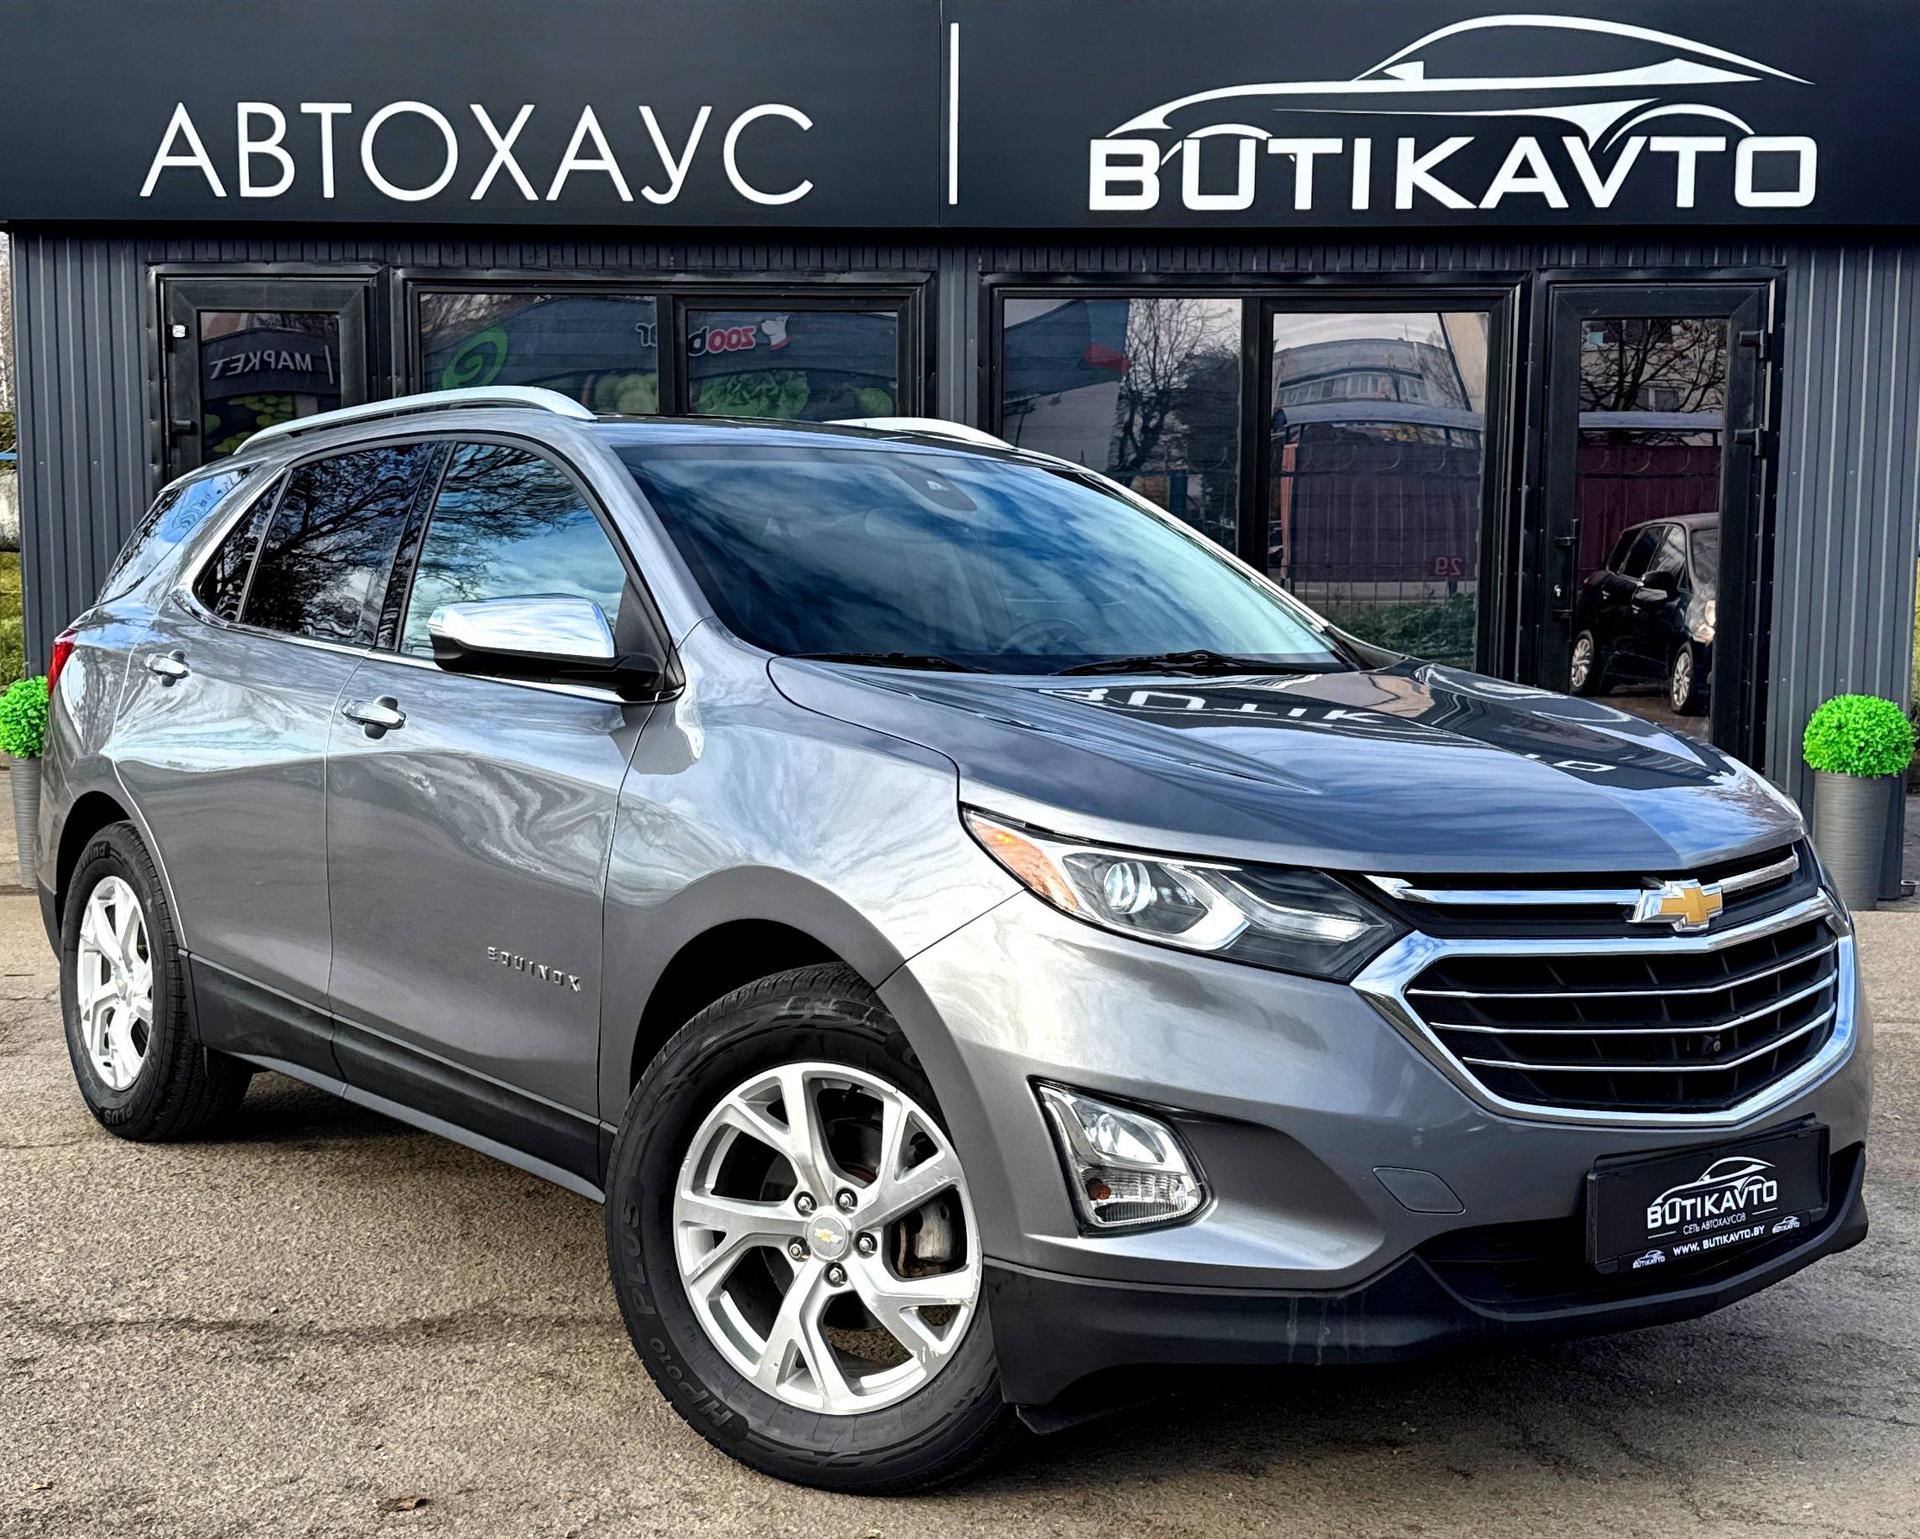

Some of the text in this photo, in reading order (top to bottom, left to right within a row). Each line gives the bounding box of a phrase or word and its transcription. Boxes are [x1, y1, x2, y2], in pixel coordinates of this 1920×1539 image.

[140, 100, 815, 205] АВТОХАУС
[1088, 135, 1818, 211] BUTIKAVTO
[487, 946, 581, 992] EQUINOX
[1647, 1180, 1778, 1230] BUTIKAVTO
